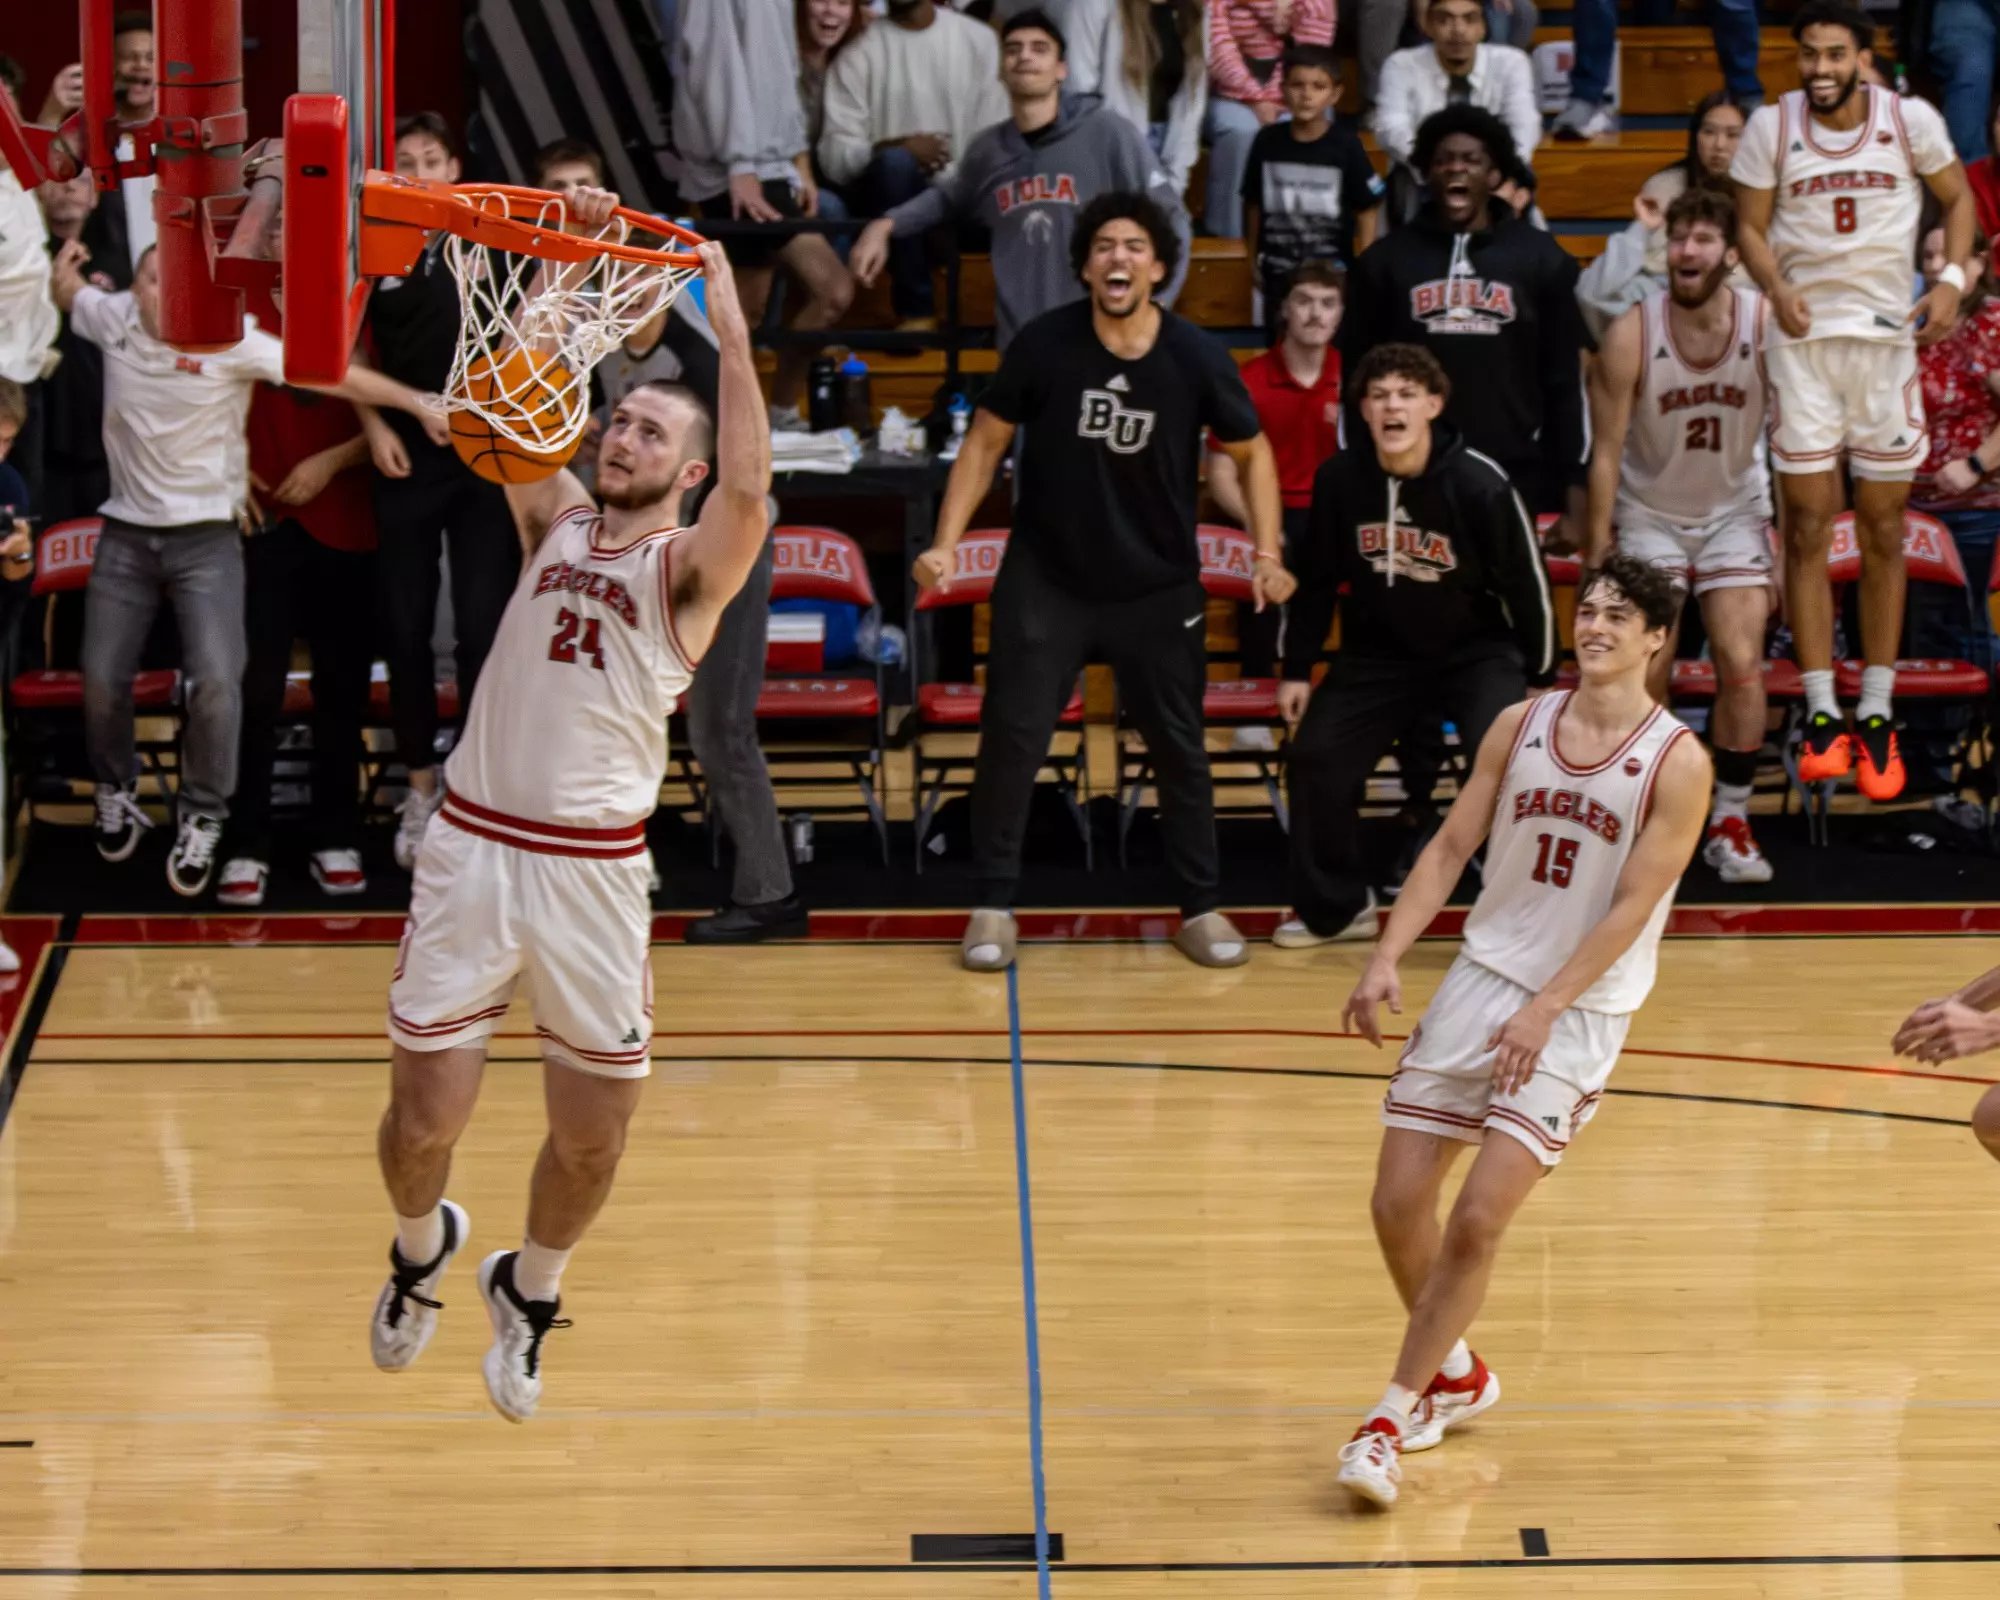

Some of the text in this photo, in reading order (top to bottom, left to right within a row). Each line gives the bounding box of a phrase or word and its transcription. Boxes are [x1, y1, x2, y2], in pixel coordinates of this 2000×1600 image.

[1833, 197, 1857, 234] 8
[1078, 389, 1155, 453] BU
[1685, 417, 1722, 453] 21
[547, 605, 605, 670] 24
[1512, 787, 1623, 845] EAGLES
[1531, 833, 1581, 889] 15
